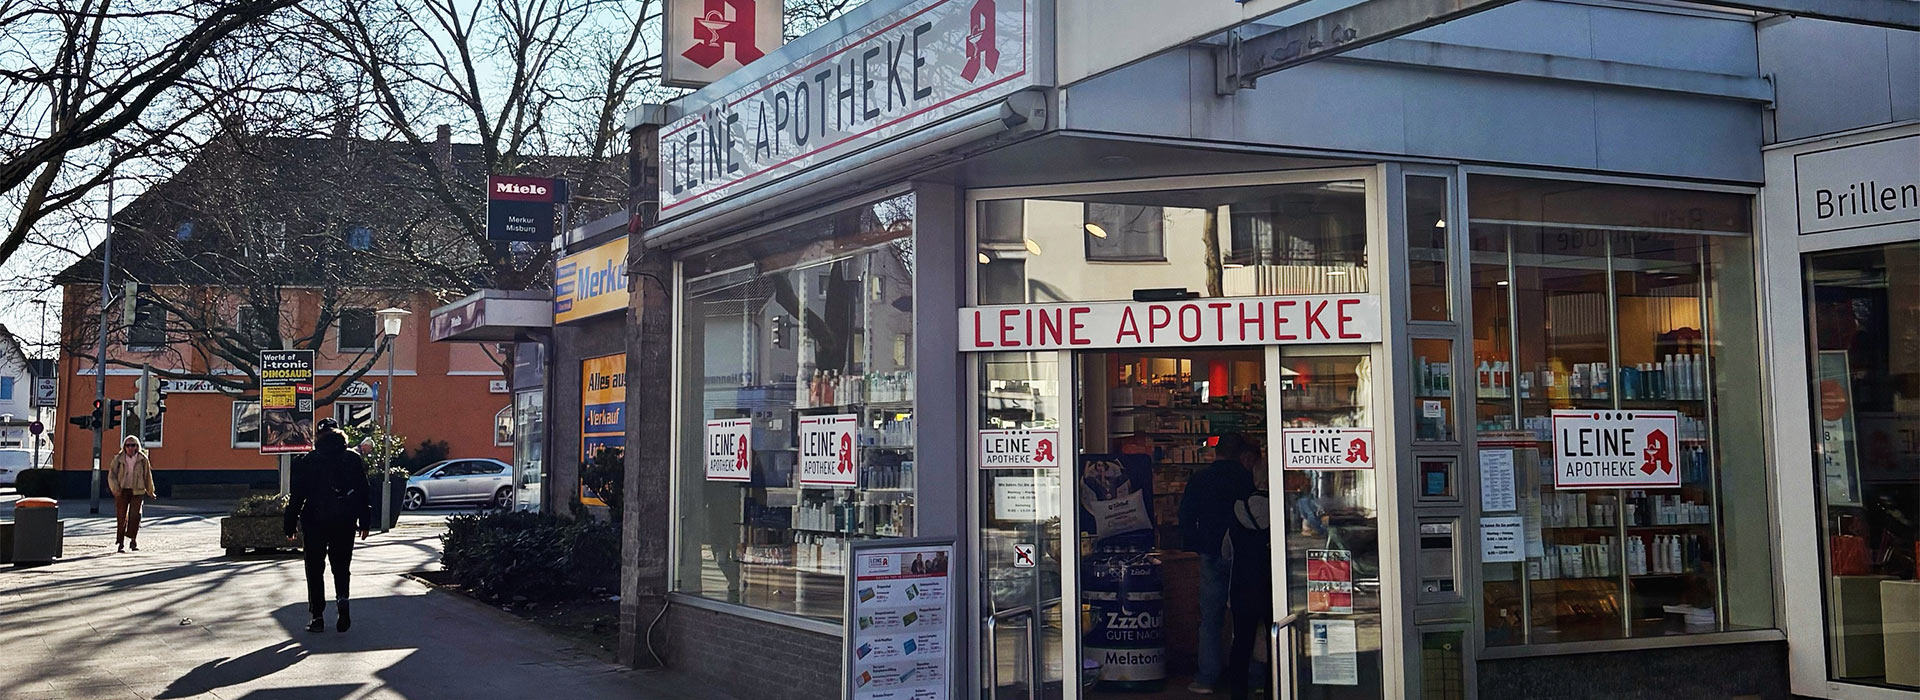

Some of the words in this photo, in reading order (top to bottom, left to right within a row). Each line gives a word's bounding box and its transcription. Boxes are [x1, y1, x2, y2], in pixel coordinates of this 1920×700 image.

[672, 112, 739, 195] LEINE
[755, 22, 932, 163] APOTHEKE
[496, 183, 547, 195] Miele
[1816, 180, 1918, 219] Brillen
[506, 225, 536, 233] Misburg
[975, 307, 1091, 347] LEINE
[1116, 299, 1362, 345] APOTHEKE
[263, 360, 308, 368] i-tronic
[262, 369, 312, 378] DINOSAURS
[176, 381, 218, 391] Pizzeri
[588, 373, 610, 391] Alles
[710, 433, 735, 456] LEINE
[804, 432, 836, 457] LEINE
[986, 439, 1030, 453] LEINE
[1291, 438, 1341, 453] LEINE
[1563, 428, 1636, 457] LEINE
[710, 459, 735, 472] APOTHEKE
[986, 455, 1030, 463] APOTHEKE
[1292, 455, 1341, 464] APOTHEKE
[804, 461, 836, 475] APOTHEKE
[1566, 461, 1636, 477] APOTHEKE
[1106, 630, 1134, 640] GUTE
